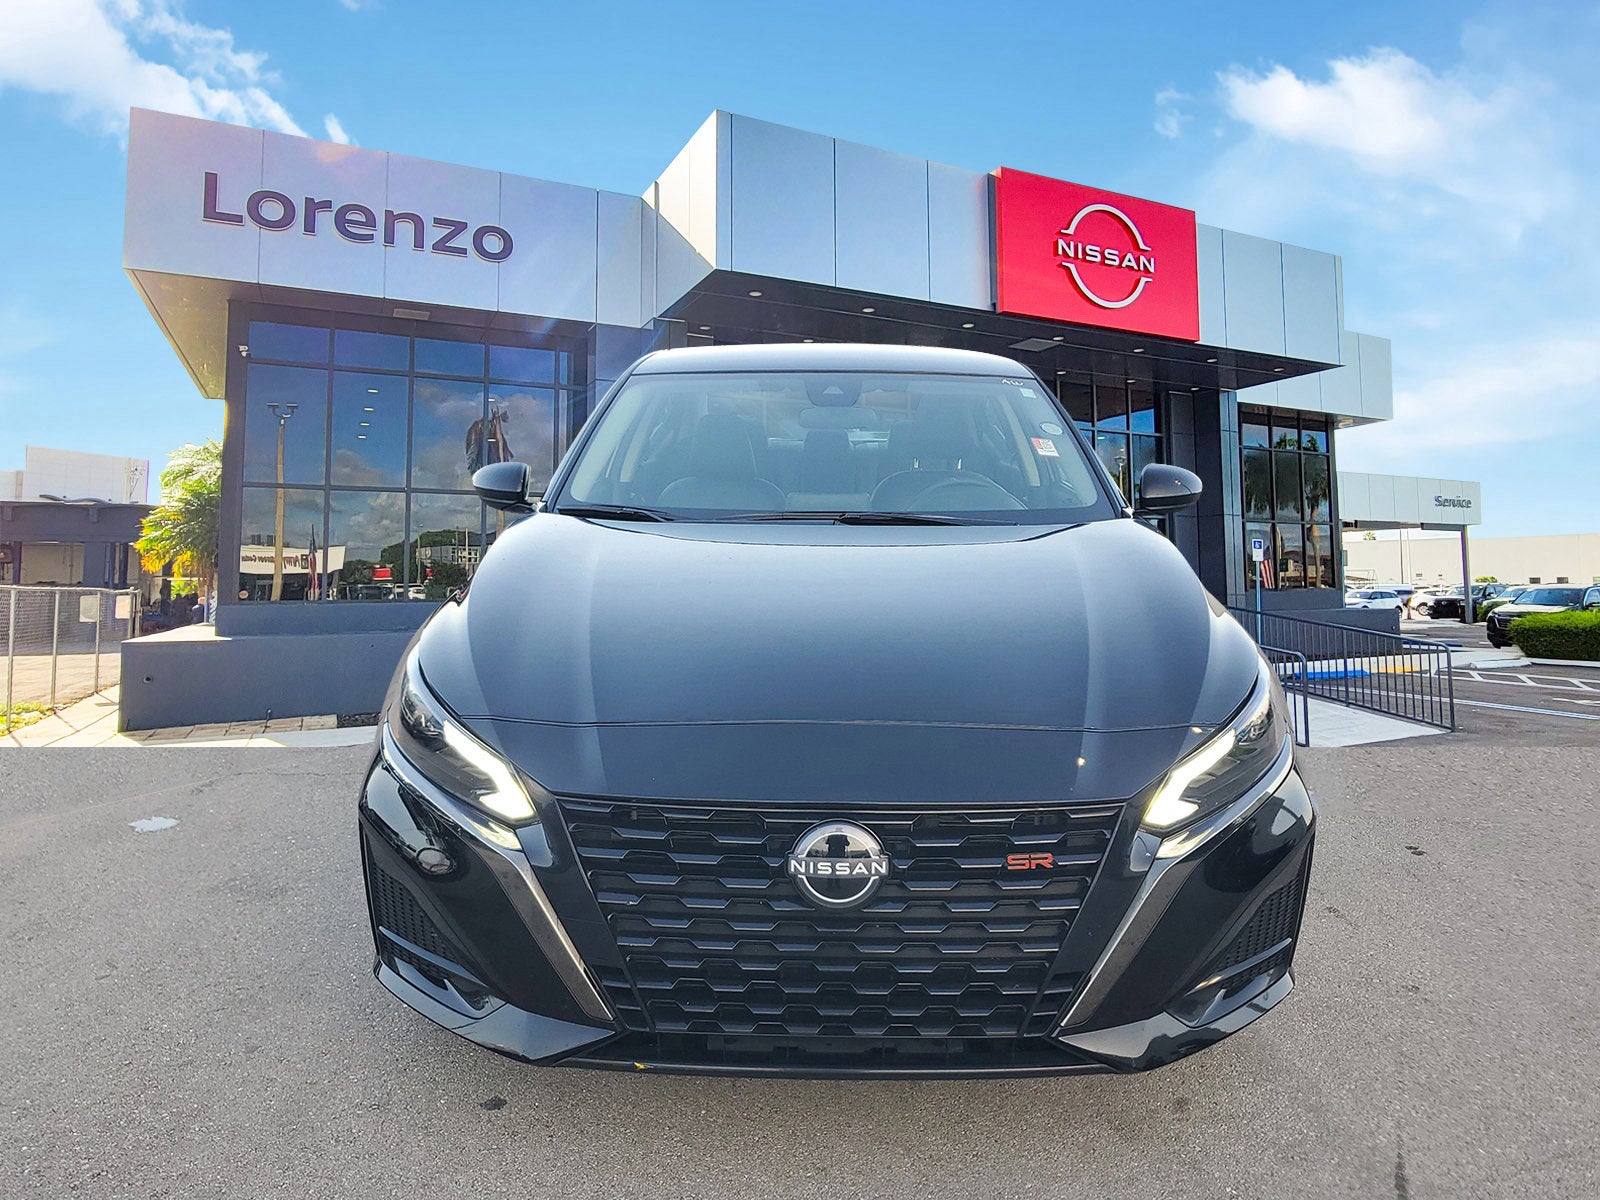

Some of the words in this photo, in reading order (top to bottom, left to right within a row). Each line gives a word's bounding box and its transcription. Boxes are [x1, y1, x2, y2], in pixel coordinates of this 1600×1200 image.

[202, 171, 514, 262] Lorenzo
[1057, 238, 1155, 273] NISSAN
[1434, 495, 1472, 509] Service
[790, 859, 887, 875] NISSAN
[1006, 853, 1053, 871] SR
